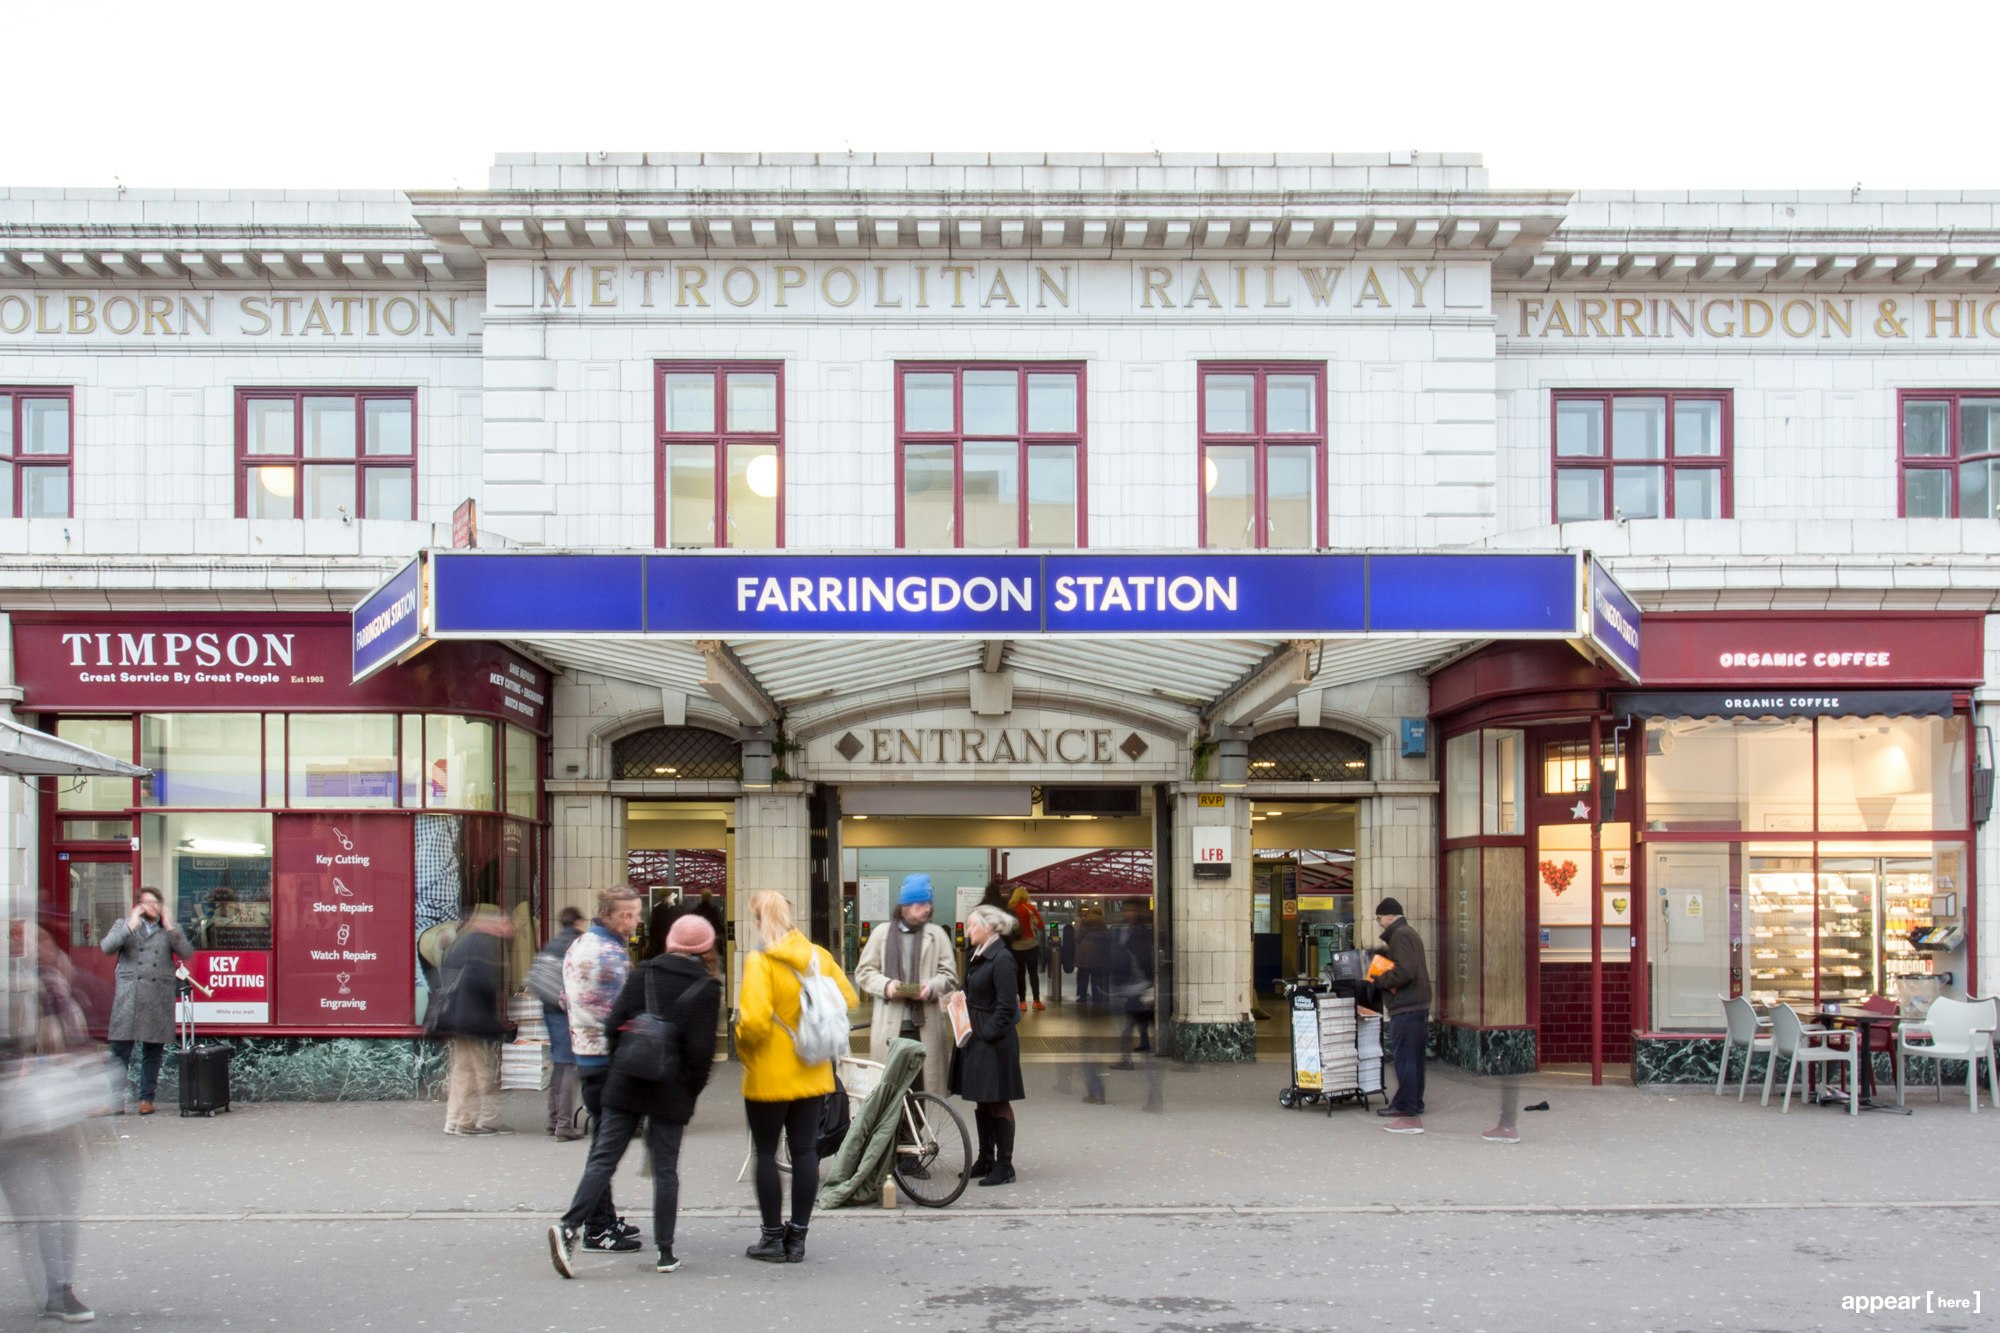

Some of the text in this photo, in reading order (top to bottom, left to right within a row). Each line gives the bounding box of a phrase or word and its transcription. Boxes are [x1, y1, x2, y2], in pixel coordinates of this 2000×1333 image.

[538, 265, 1436, 308] METROPOLITAN RAILWAY
[240, 296, 457, 336] STATION
[1517, 298, 1854, 338] FARRINGDON
[1873, 299, 1908, 338] &
[737, 576, 1237, 612] FARRINGDON STATION
[356, 588, 416, 652] FARRINGDON STATION
[61, 633, 295, 667] TIMPSON
[1719, 652, 1890, 668] ORGANIC COFFEE
[79, 672, 280, 684] Great Service By Great People
[290, 675, 324, 684] Est 1903
[490, 673, 504, 687] KEY
[1725, 698, 1839, 708] ORGANIC COFFEE
[869, 728, 1114, 764] ENTRANCE
[1201, 795, 1223, 805] RVP
[316, 854, 370, 867] Key Cutting
[1201, 848, 1224, 861] LFB
[313, 902, 374, 915] Shoe Repairs
[310, 949, 377, 963] Watch Repairs
[209, 956, 239, 972] KEY
[209, 974, 265, 988] CUTTING
[320, 998, 366, 1011] Engraving
